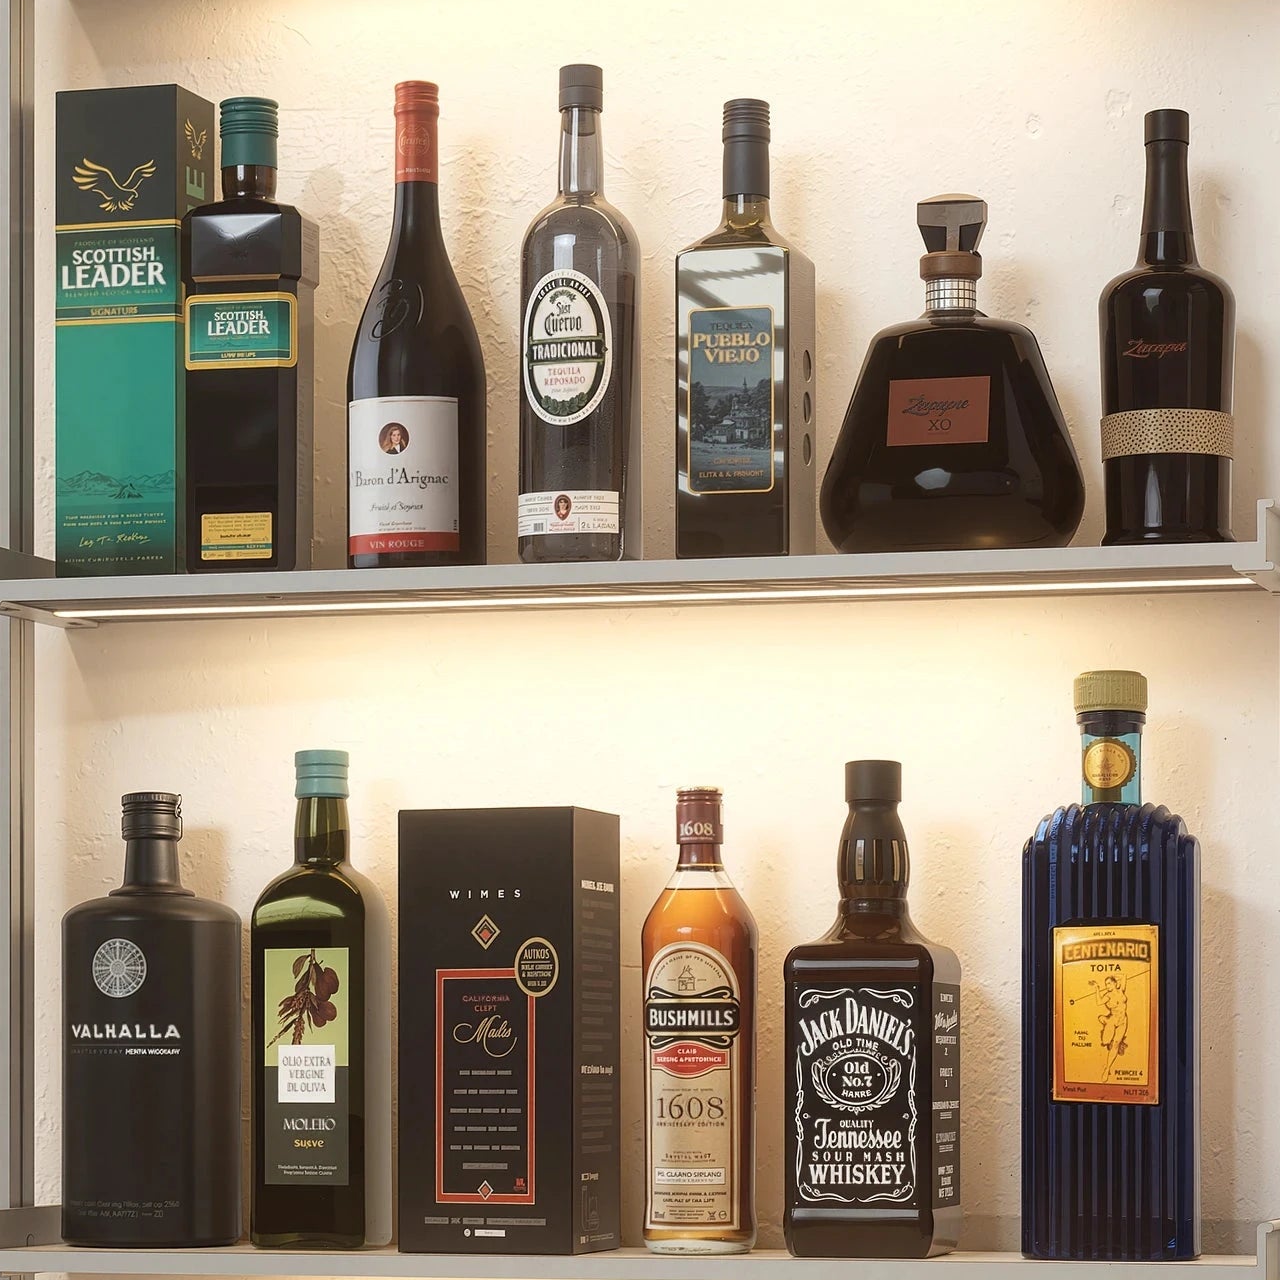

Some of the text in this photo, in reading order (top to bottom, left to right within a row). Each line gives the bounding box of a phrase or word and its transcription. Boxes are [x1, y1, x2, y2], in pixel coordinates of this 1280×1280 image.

[72, 246, 155, 266] SCOTTISH
[62, 261, 167, 291] LEADER
[214, 310, 264, 322] SCOTTISH
[207, 320, 271, 337] LEADER
[693, 331, 771, 349] PUEBLO
[532, 340, 598, 361] TRADICIONAL
[704, 348, 761, 364] VIEJO
[548, 367, 582, 380] TEQUILA
[544, 376, 586, 391] REPOSADO
[927, 418, 952, 431] XO
[355, 470, 384, 487] Baron
[369, 539, 425, 551] VIN ROUGE
[449, 889, 521, 899] WIMES
[1090, 963, 1122, 973] TOITA
[649, 1007, 734, 1027] BUSHMILLS
[72, 1023, 182, 1039] VALHALLA
[798, 997, 915, 1057] JACK DANIEL'S
[832, 1038, 879, 1052] OLD TIME
[282, 1055, 331, 1067] OLIO EXTRA
[844, 1061, 870, 1075] Old
[289, 1069, 325, 1079] VERGINE
[300, 1082, 326, 1092] OLIVA
[839, 1119, 875, 1129] QUALITY
[813, 1118, 902, 1150] Tennessee
[812, 1151, 905, 1162] SOUR MASH
[808, 1163, 906, 1185] WHISKEY
